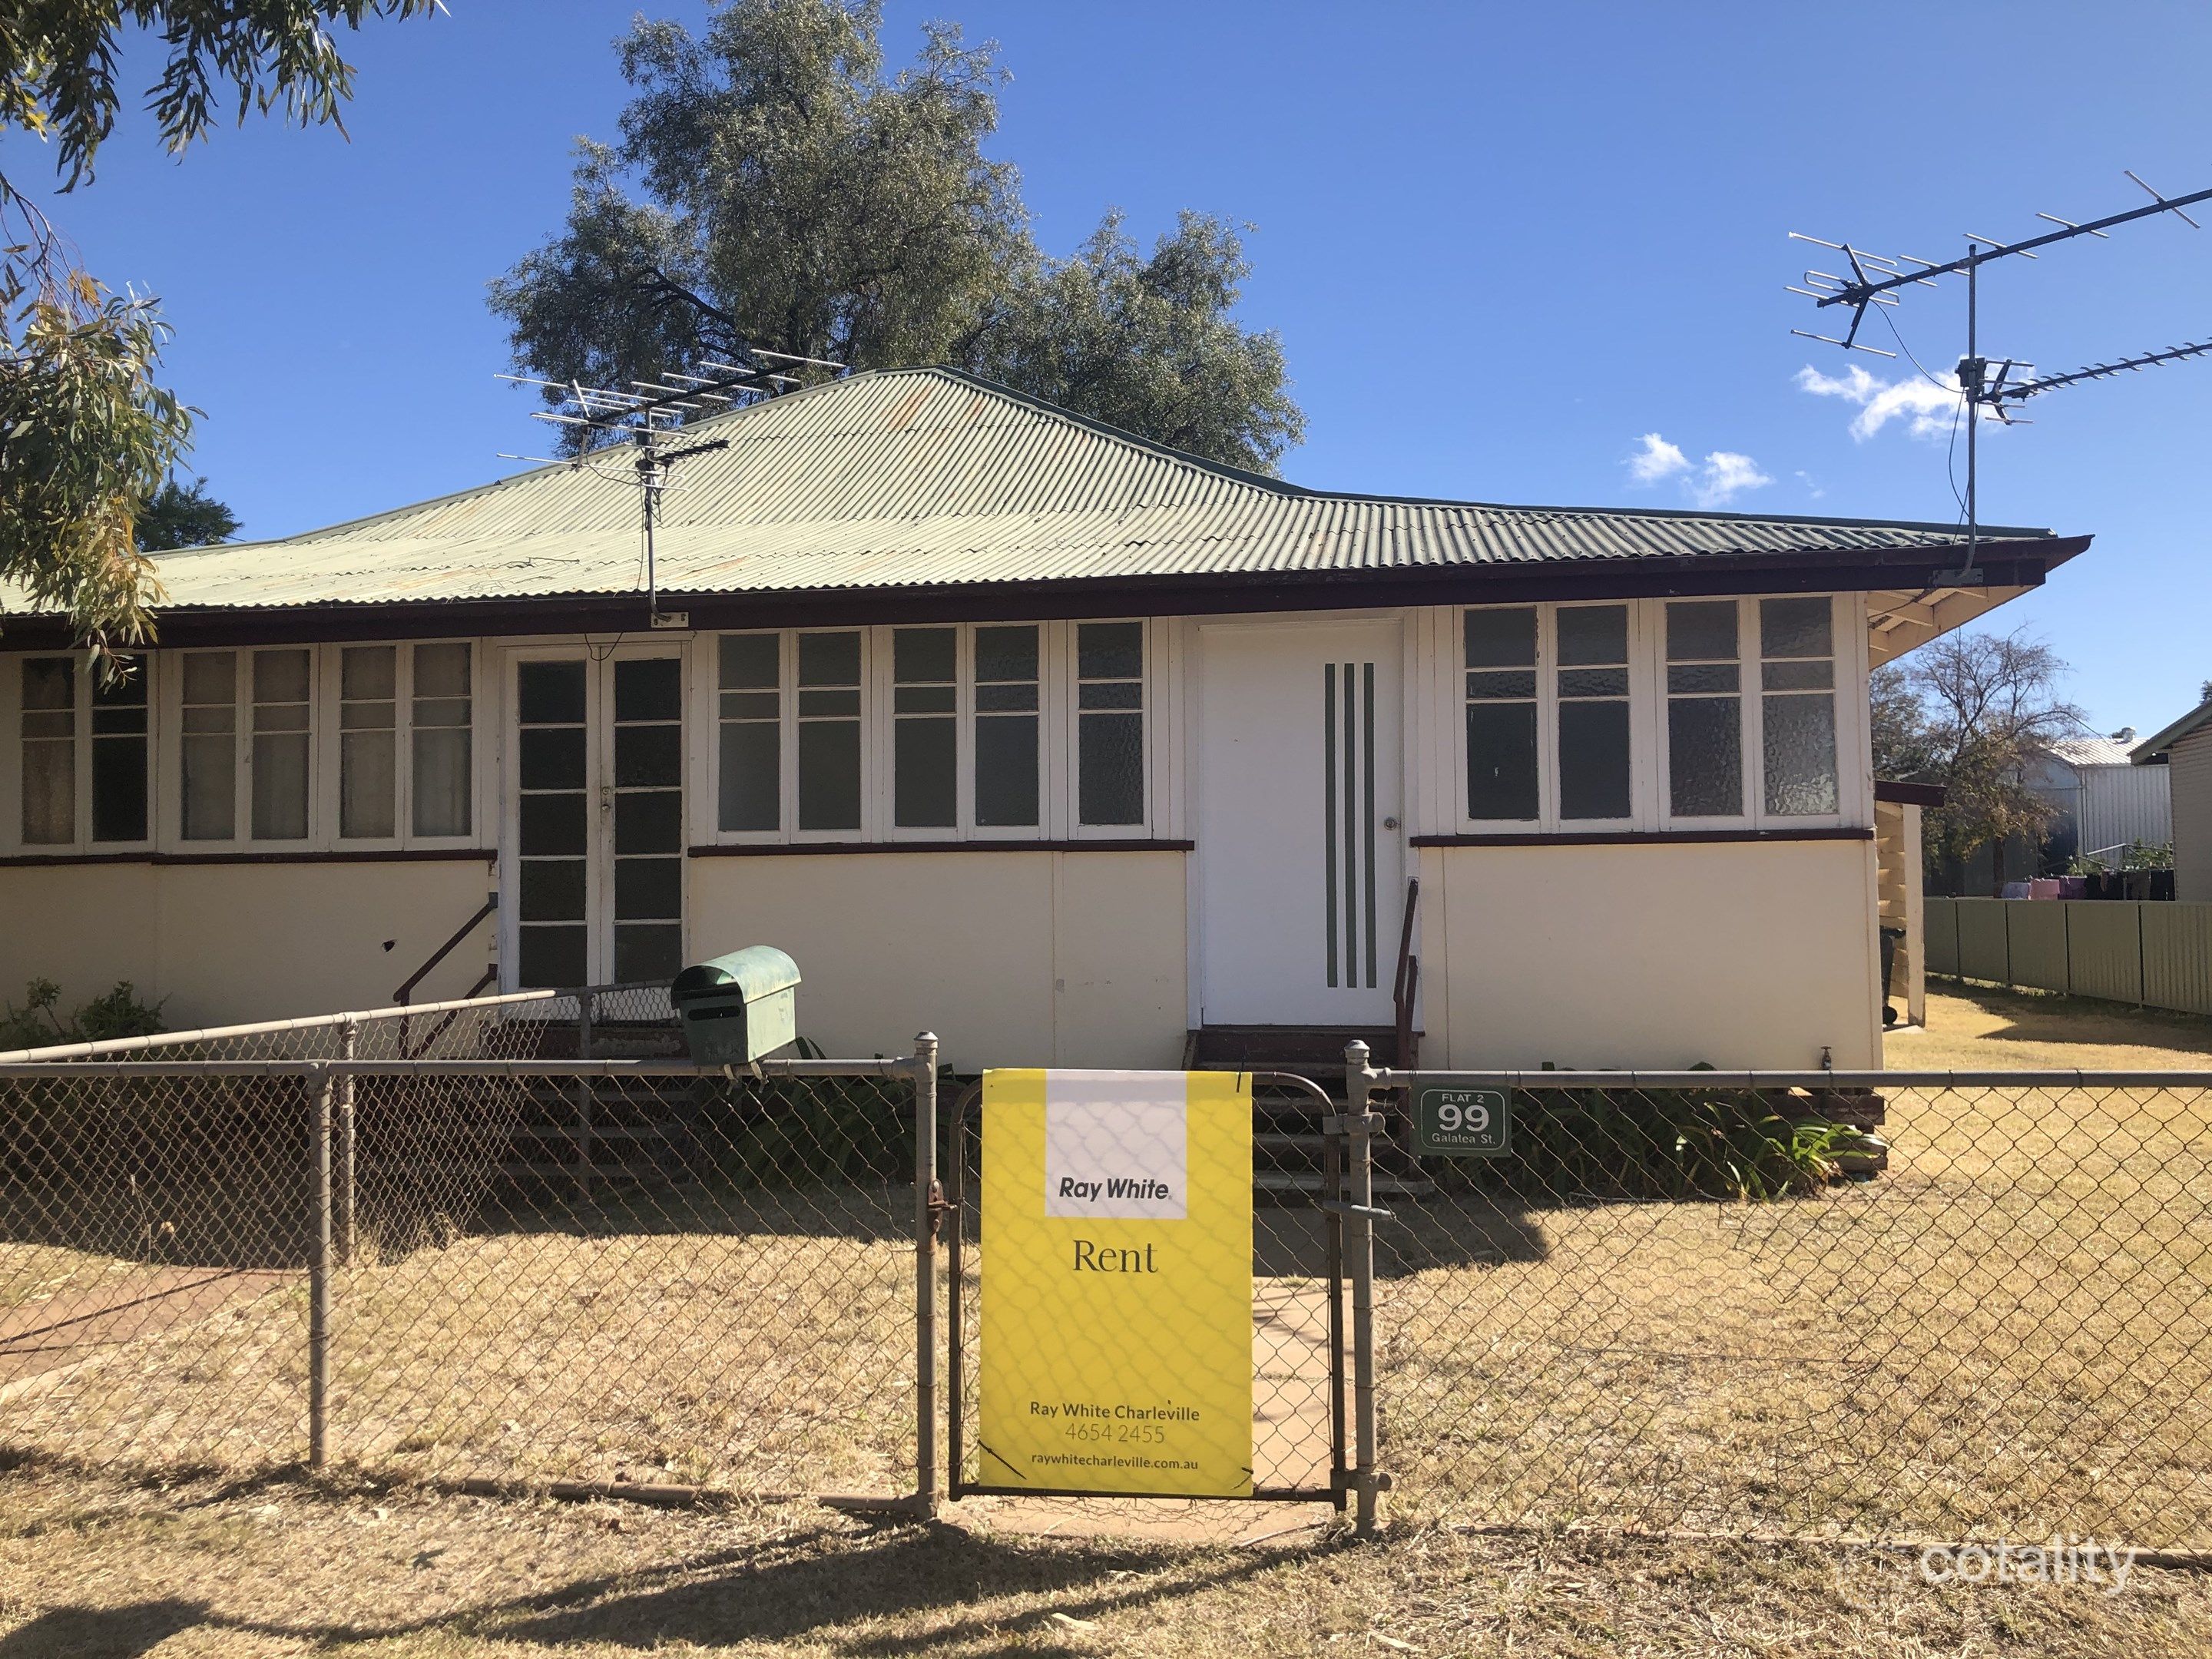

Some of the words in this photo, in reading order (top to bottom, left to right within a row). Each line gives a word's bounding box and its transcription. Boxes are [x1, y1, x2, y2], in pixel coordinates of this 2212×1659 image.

[1442, 1094, 1472, 1103] FLAT
[1477, 1094, 1485, 1103] 2
[1438, 1104, 1489, 1132] 99
[1432, 1133, 1476, 1144] Galatea
[1481, 1134, 1496, 1145] St.
[1059, 1177, 1102, 1202] Ray
[1107, 1177, 1169, 1200] White
[1073, 1240, 1159, 1273] Rent
[1030, 1402, 1058, 1419] Ray
[1063, 1403, 1111, 1419] White
[1114, 1405, 1200, 1422] Charleville
[1065, 1422, 1113, 1442] 4654
[1118, 1424, 1165, 1444] 2455
[1031, 1452, 1198, 1471] raywhitecharleville.com.au
